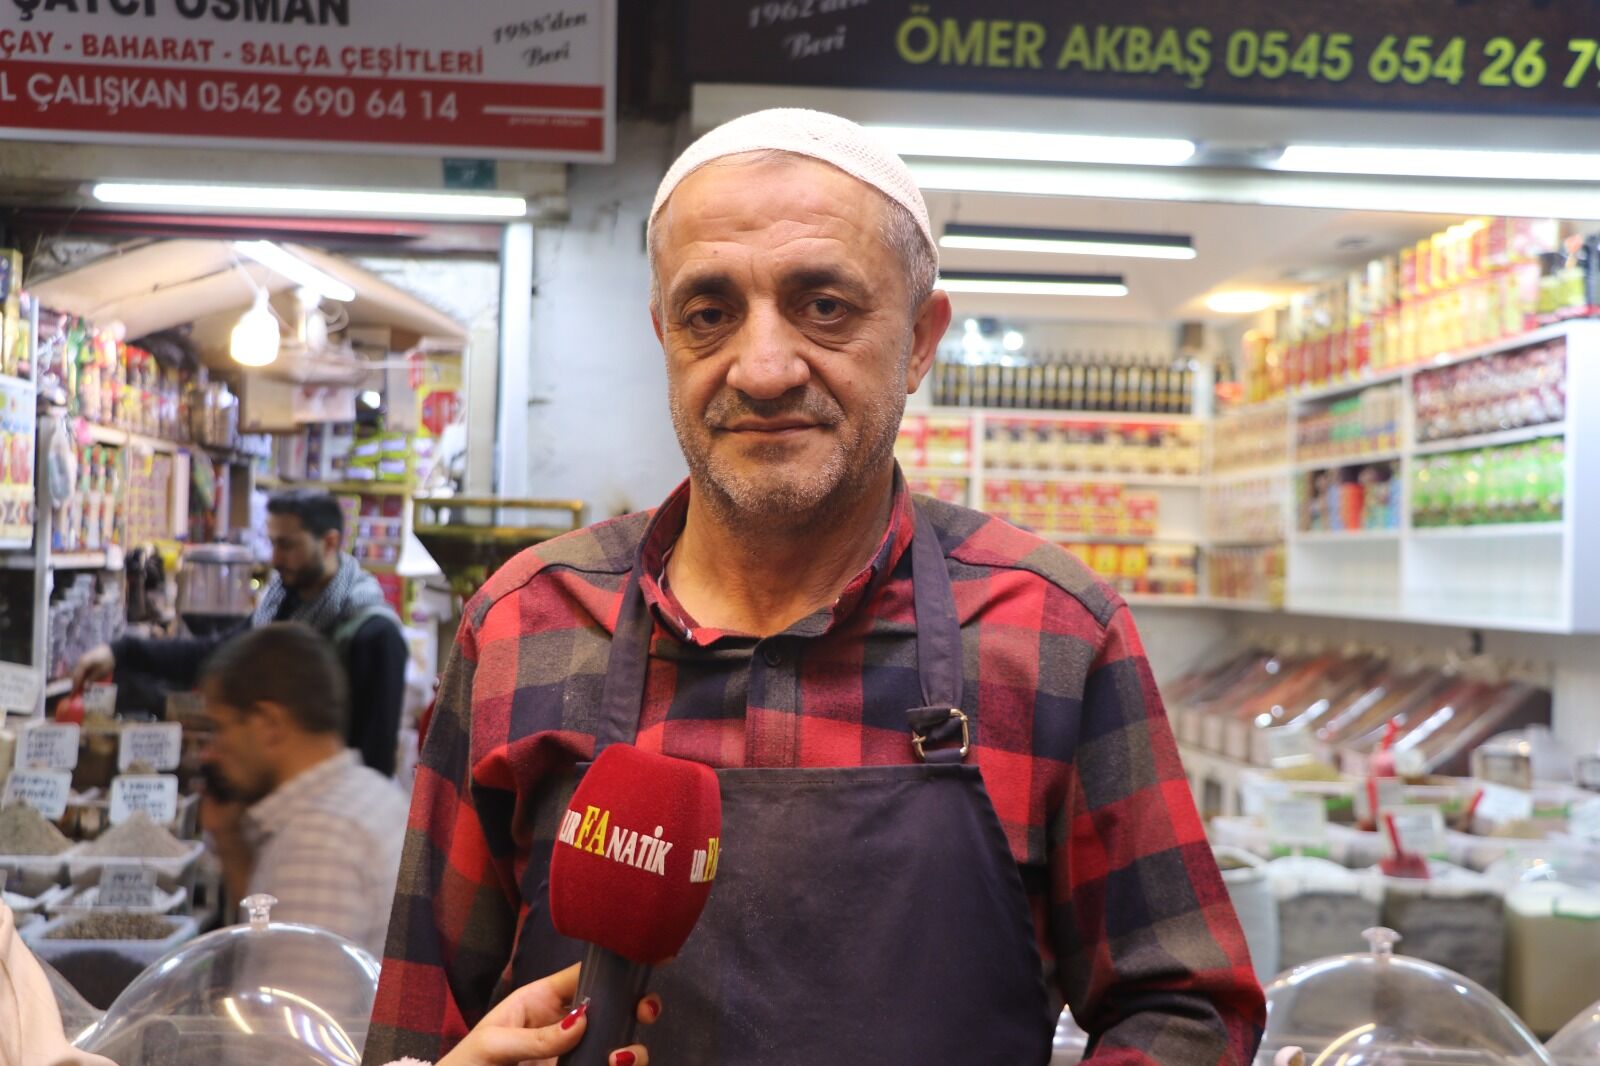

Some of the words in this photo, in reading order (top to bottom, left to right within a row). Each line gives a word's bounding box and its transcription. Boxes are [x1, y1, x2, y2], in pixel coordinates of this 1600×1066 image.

[175, 0, 350, 26] OSMAN
[0, 29, 54, 58] ÇAY
[81, 33, 215, 63] BAHARAT
[241, 42, 332, 73] SALÇA
[340, 43, 484, 77] ÇEŞİTLERİ
[521, 40, 571, 68] Beri
[779, 25, 847, 60] Beri
[895, 3, 1047, 69] ÖMER
[1056, 25, 1214, 90] AKBAŞ
[1226, 30, 1354, 82] 0545
[1367, 35, 1467, 86] 654
[1478, 36, 1548, 89] 26
[1561, 38, 1600, 89] 7
[27, 72, 187, 115] ÇALIŞKAN
[198, 80, 282, 114] 0542
[293, 86, 355, 118] 690
[365, 90, 407, 119] 64
[419, 91, 459, 122] 14
